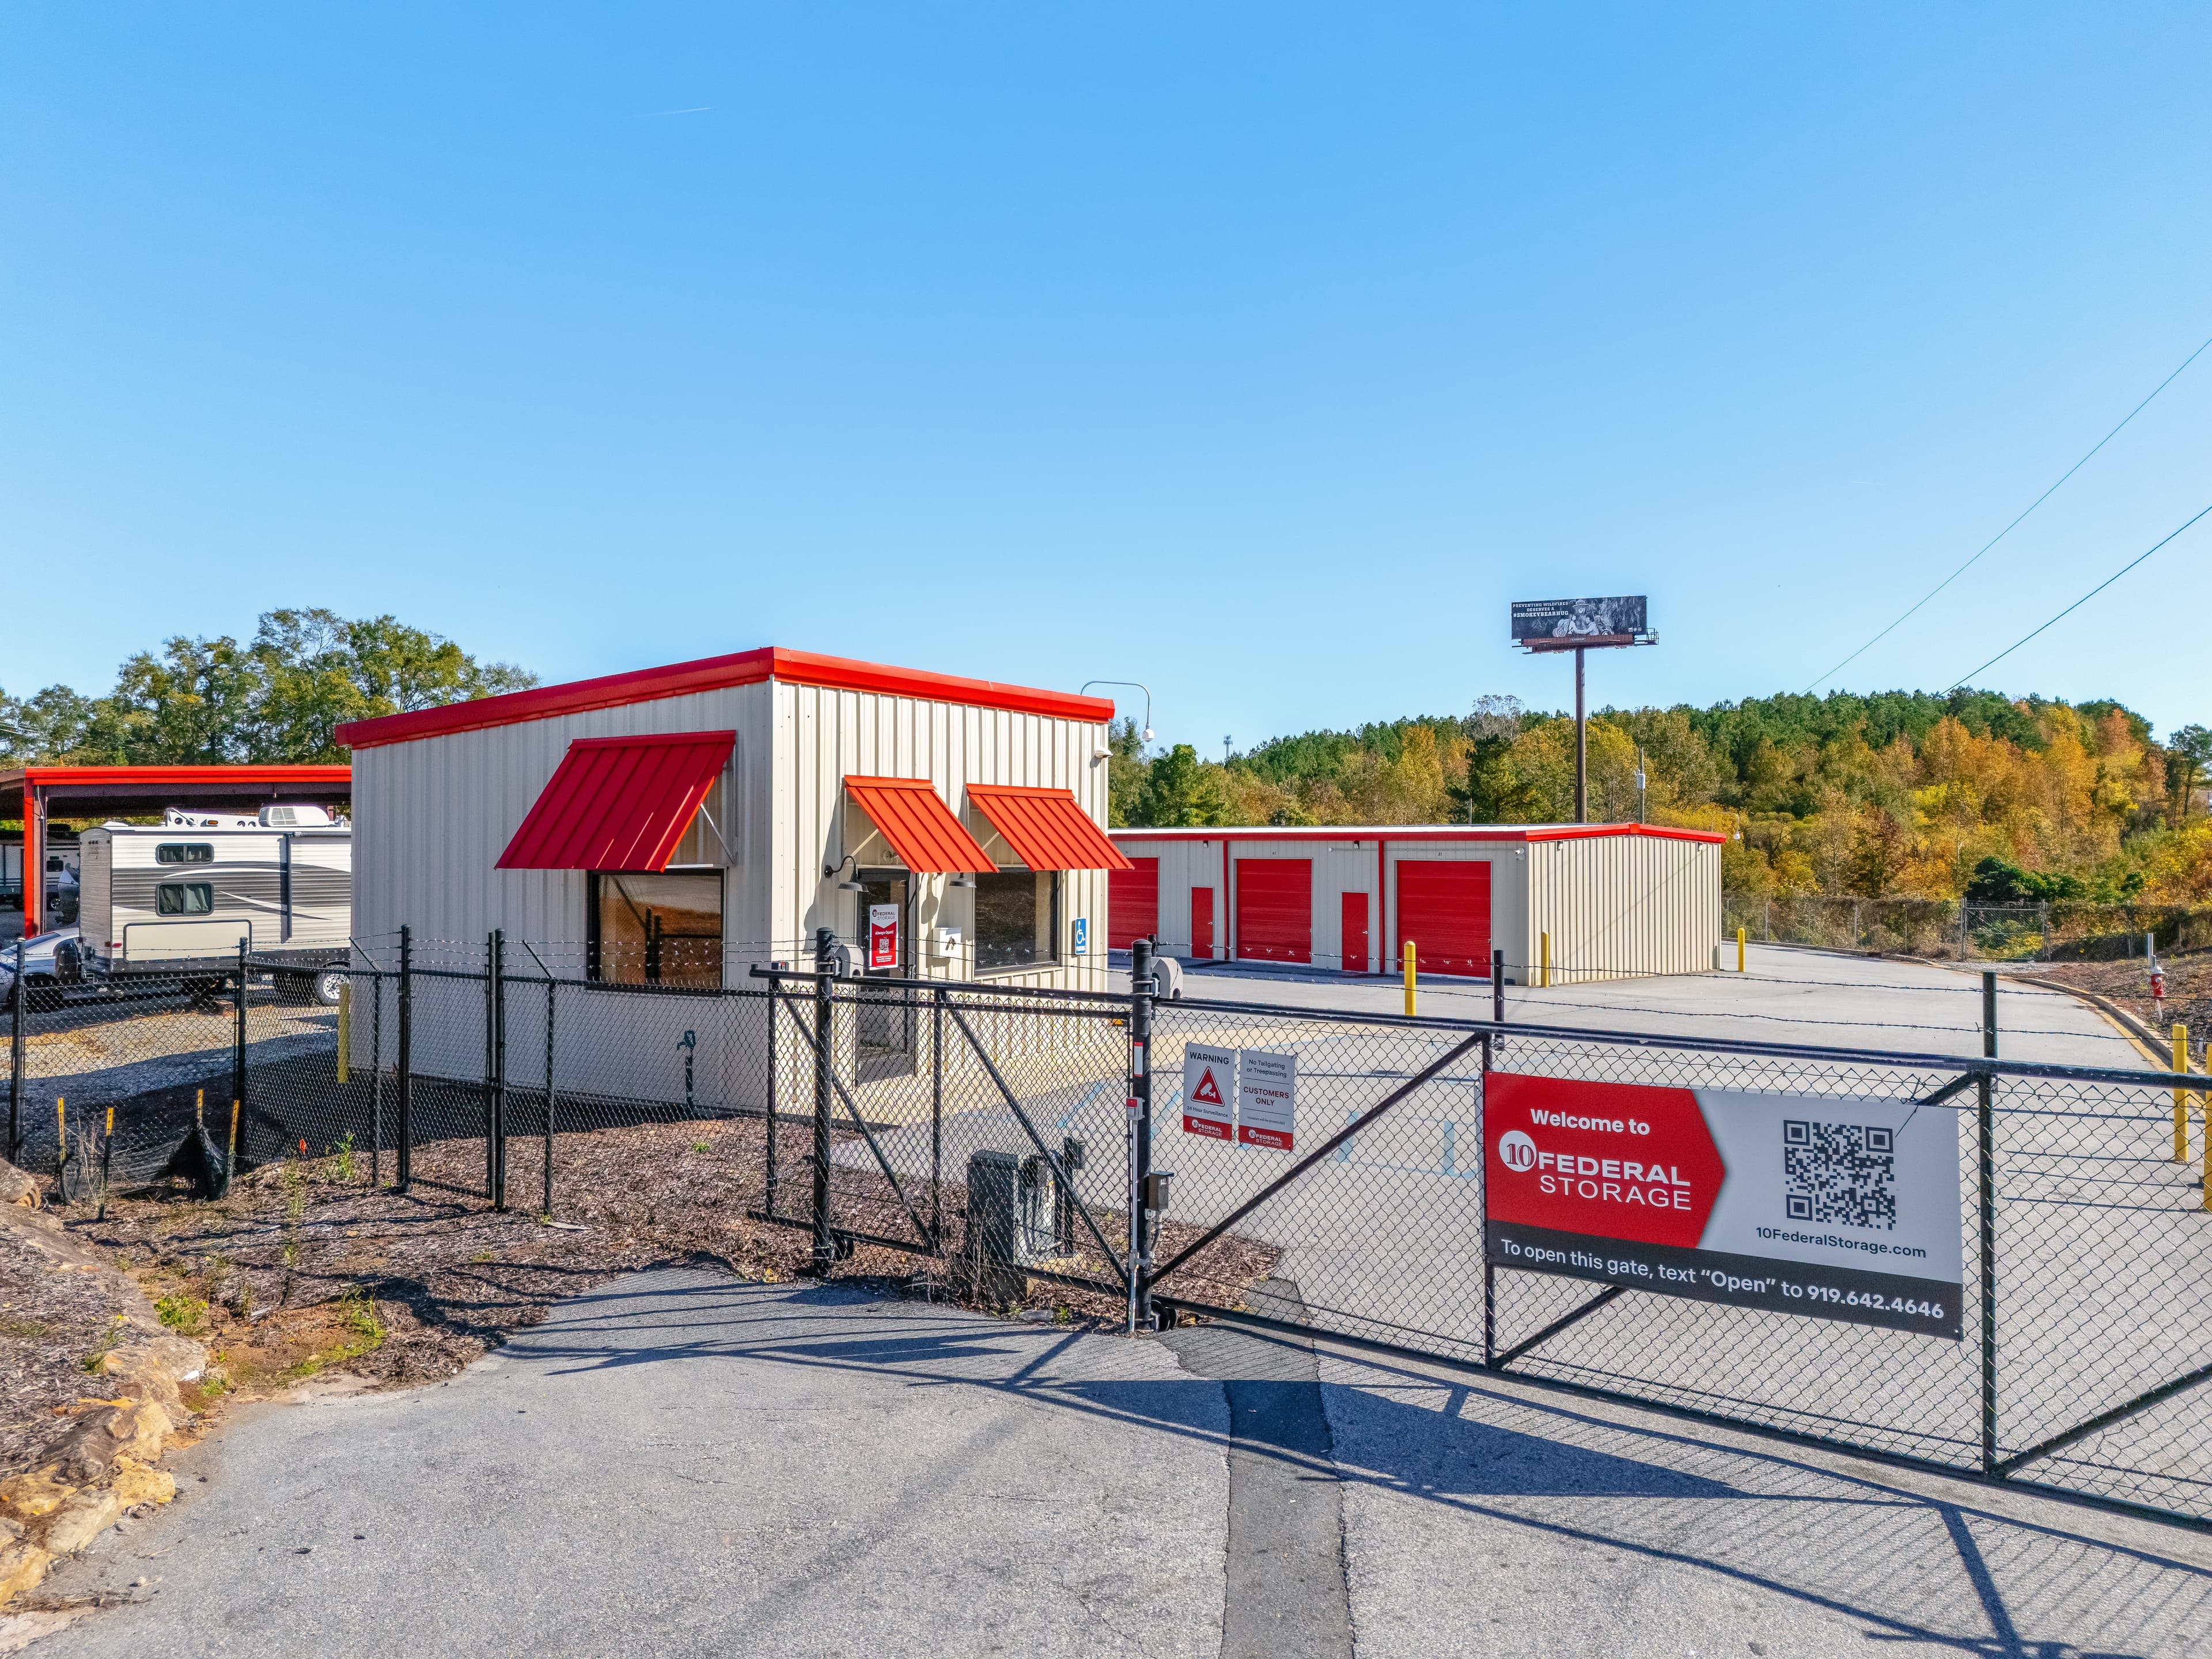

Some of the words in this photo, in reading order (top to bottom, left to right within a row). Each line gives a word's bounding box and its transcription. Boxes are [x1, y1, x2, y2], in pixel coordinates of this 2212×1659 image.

[1190, 1051, 1229, 1065] WARNING
[1257, 1060, 1285, 1070] Tailgating
[1253, 1068, 1287, 1078] Trespassing
[1243, 1086, 1289, 1099] CUSTOMERS
[1255, 1097, 1275, 1107] ONLY
[1203, 1109, 1229, 1118] Surveillance
[1530, 1108, 1624, 1133] Welcome
[1628, 1119, 1650, 1135] to
[1198, 1123, 1222, 1132] FEDERAL
[1198, 1128, 1222, 1137] STORAGE
[1256, 1134, 1283, 1142] FEDERAL
[1256, 1139, 1283, 1147] STORAGE
[1506, 1143, 1535, 1168] 10
[1538, 1152, 1691, 1187] FEDERAL
[1539, 1175, 1691, 1211] STORAGE
[1756, 1226, 1927, 1259] 10FederalStorage.com
[1501, 1238, 1521, 1256] To
[1524, 1246, 1566, 1264] open
[1569, 1251, 1603, 1269] this
[1607, 1258, 1654, 1279] gate,
[1658, 1264, 1697, 1283] text
[1700, 1269, 1776, 1294] “Open”
[1781, 1283, 1803, 1298] to
[1807, 1285, 1945, 1319] 919.642.4646
